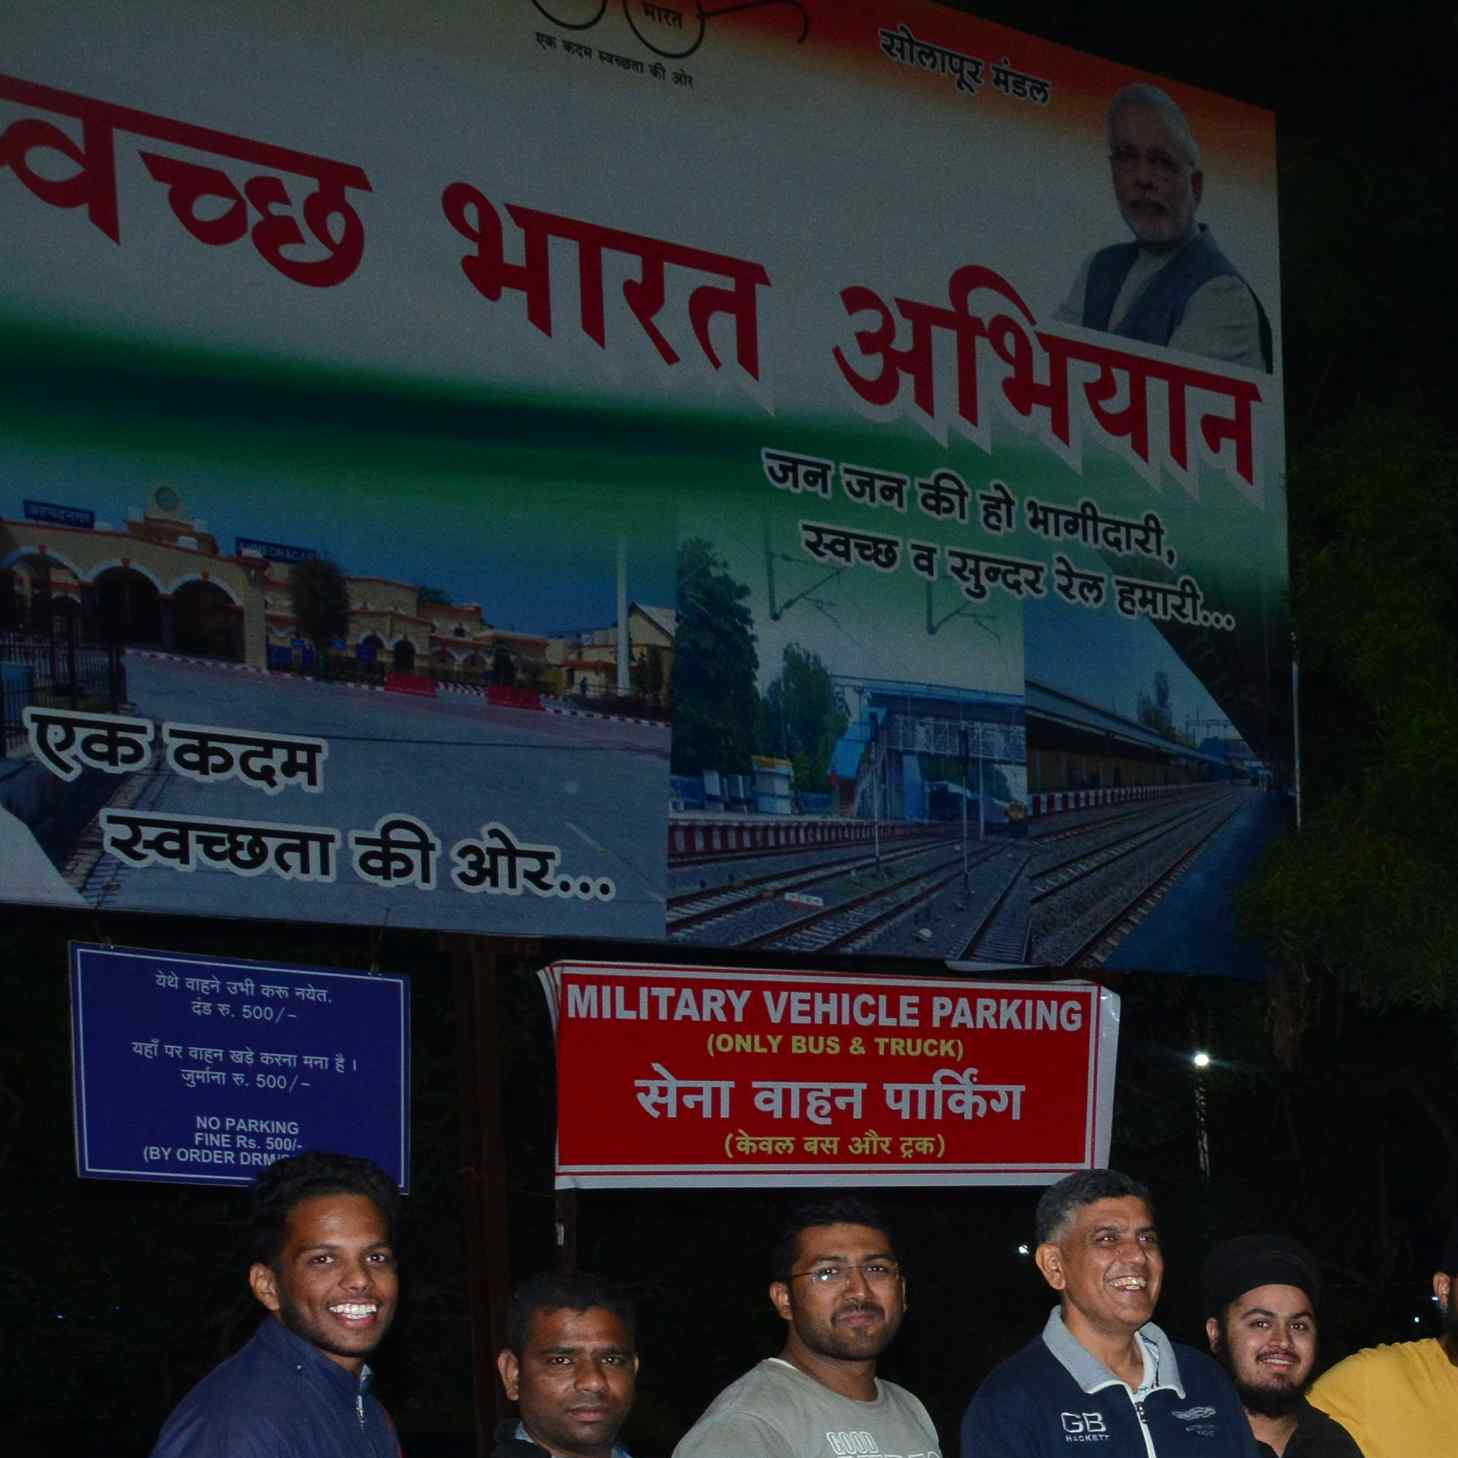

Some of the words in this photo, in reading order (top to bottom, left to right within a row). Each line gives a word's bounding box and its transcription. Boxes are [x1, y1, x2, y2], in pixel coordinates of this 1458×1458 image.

[535, 32, 557, 50] एक
[562, 40, 592, 59] कदम
[648, 62, 666, 80] की
[671, 67, 694, 88] ओर
[881, 27, 982, 93] सोलापूर
[993, 60, 1049, 102] मंडल
[0, 74, 373, 288] वच्छ
[442, 183, 771, 381] भारत
[834, 265, 1262, 486] अभियान
[766, 451, 829, 495] जन
[844, 469, 906, 508] जन
[919, 474, 969, 517] की
[981, 484, 1014, 530] हो
[1027, 501, 1175, 565] भागीदारी,
[802, 522, 897, 568] स्वच्छ
[912, 544, 936, 577] व
[949, 550, 1044, 597] सुन्दर
[1055, 557, 1103, 603] रेल
[1116, 579, 1234, 630] हमारी...
[30, 713, 148, 777] एक
[168, 728, 322, 786] कदम
[107, 814, 334, 875] स्वच्छता
[354, 819, 436, 884] की
[456, 828, 611, 893] ओर...
[155, 969, 179, 990] येथे
[185, 974, 220, 995] वाहने
[225, 977, 254, 997] उभी
[567, 984, 753, 1024] MILITARY
[764, 991, 920, 1029] VEHICLE
[932, 995, 1083, 1032] PARKING
[131, 1038, 160, 1060] यहाँ
[164, 1044, 184, 1060] पर
[187, 1046, 225, 1064] वाहन
[260, 1052, 298, 1068] करना
[302, 1055, 329, 1070] मना
[335, 1052, 345, 1074] है
[706, 1032, 783, 1057] (ONLY
[791, 1035, 840, 1056] BUS
[848, 1037, 867, 1057] &
[873, 1037, 965, 1061] TRUCK)
[179, 1066, 227, 1089] जुर्माना
[633, 1062, 735, 1121] सेना
[751, 1079, 867, 1125] वाहन
[884, 1069, 1026, 1122] पार्किंग
[194, 1132, 233, 1148] FINE
[236, 1135, 262, 1149] Rs.
[266, 1137, 303, 1152] 500/-
[195, 1115, 221, 1130] NO
[225, 1118, 299, 1135] PARKING
[723, 1129, 795, 1158] (केवल
[804, 1134, 839, 1156] बस
[848, 1128, 892, 1156] और
[143, 1145, 172, 1162] (BY
[176, 1148, 235, 1164] ORDER
[1060, 1412, 1107, 1433] GB
